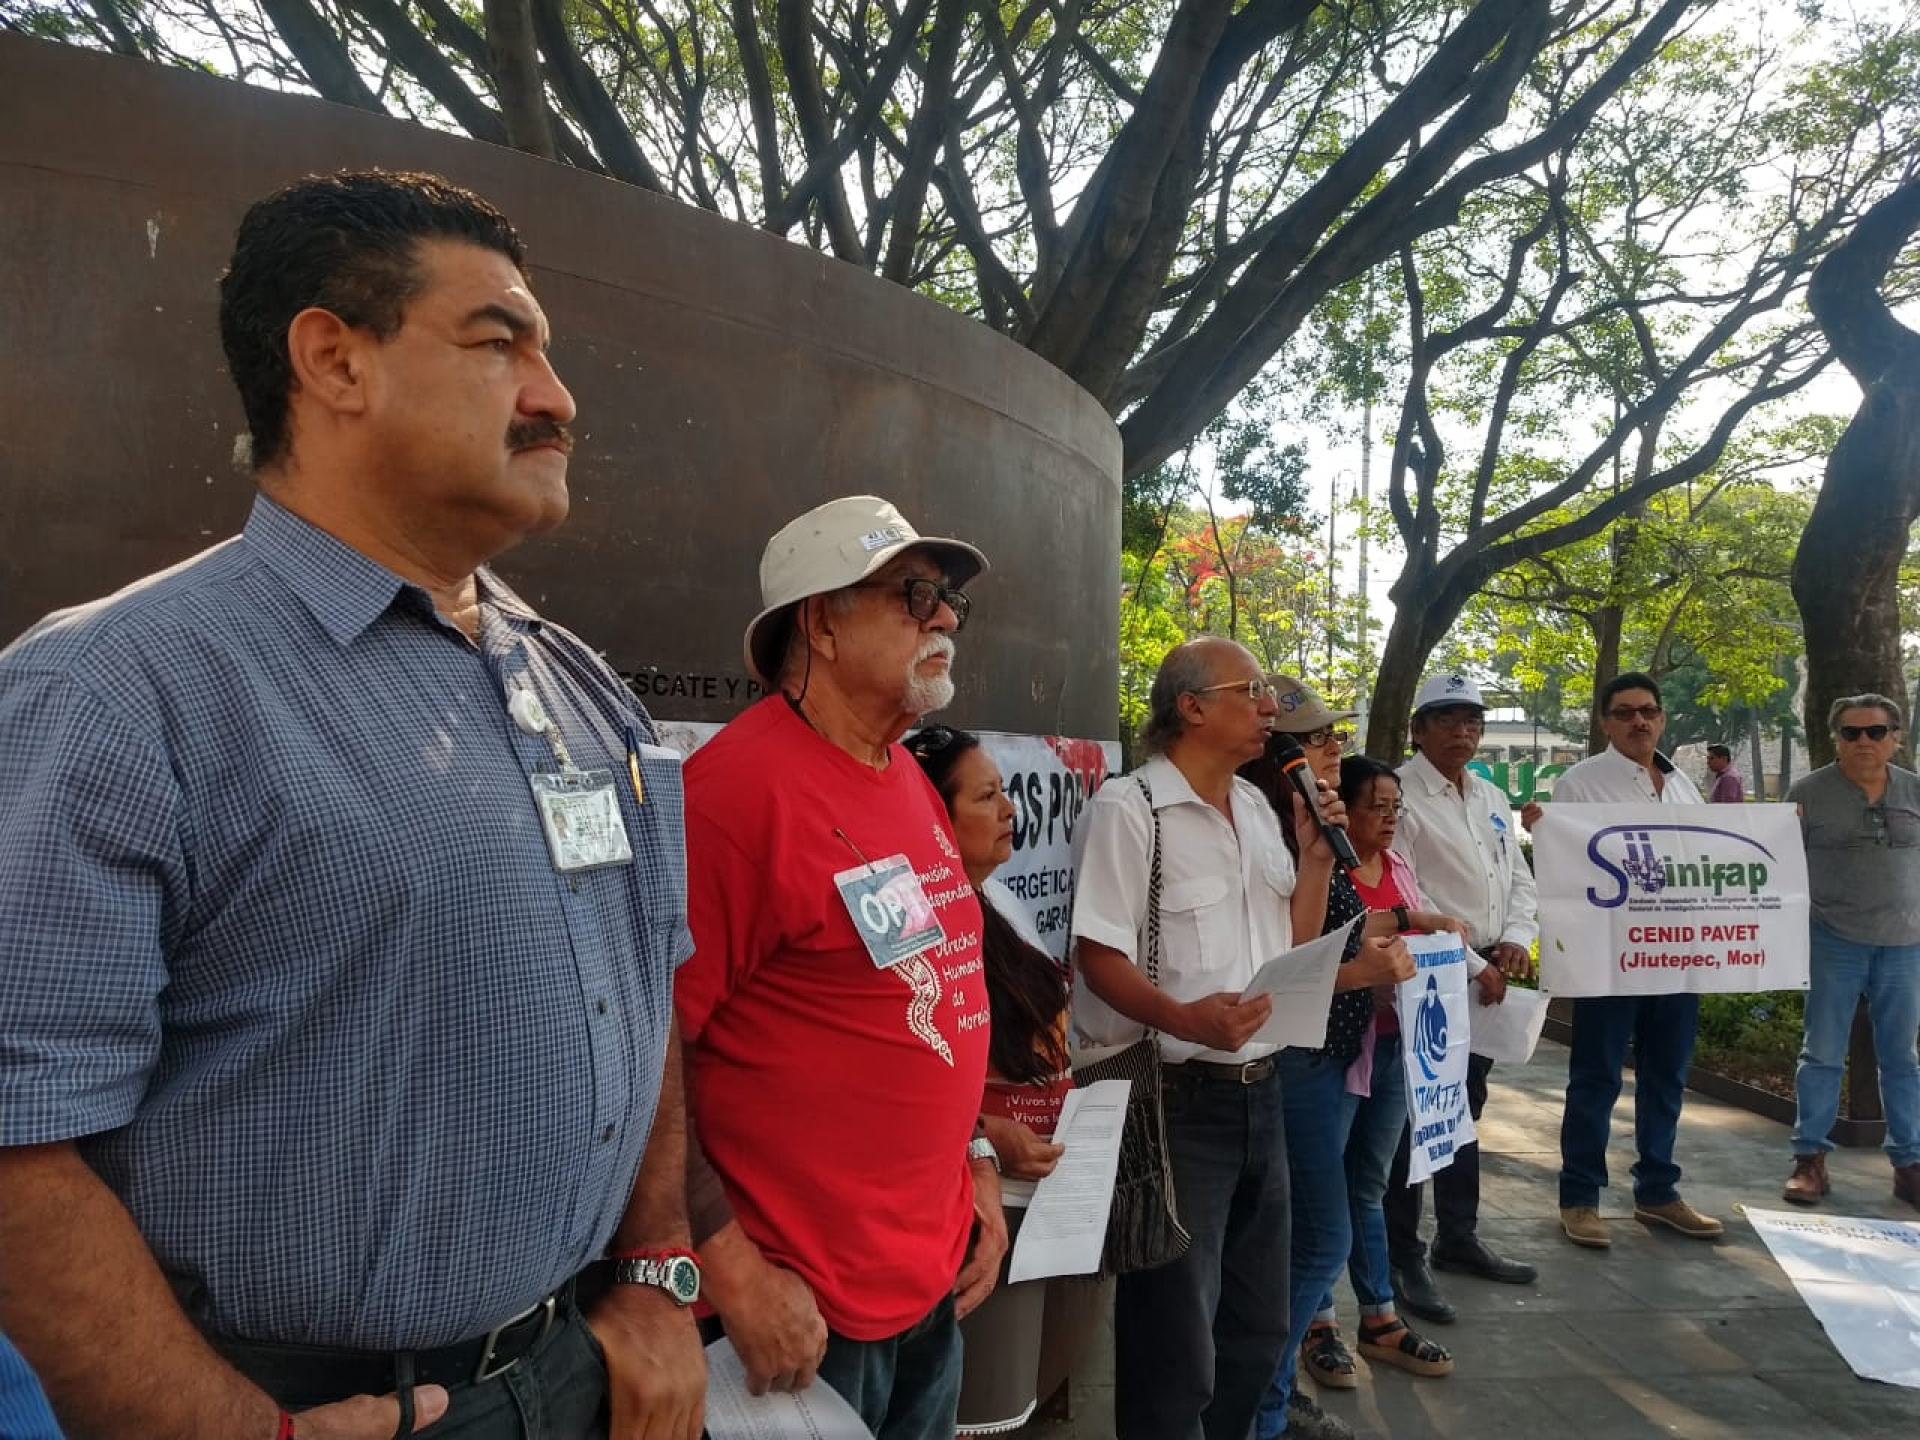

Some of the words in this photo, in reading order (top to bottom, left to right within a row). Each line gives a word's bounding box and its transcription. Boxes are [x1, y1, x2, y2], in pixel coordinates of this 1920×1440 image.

[726, 678, 739, 699] Y
[1628, 926, 1695, 943] CENID
[1701, 924, 1759, 941] PAVET
[1619, 952, 1721, 972] (Jiutepec,
[1727, 950, 1765, 967] Mor)
[952, 986, 966, 1008] de
[1012, 1111, 1049, 1123] Vivos
